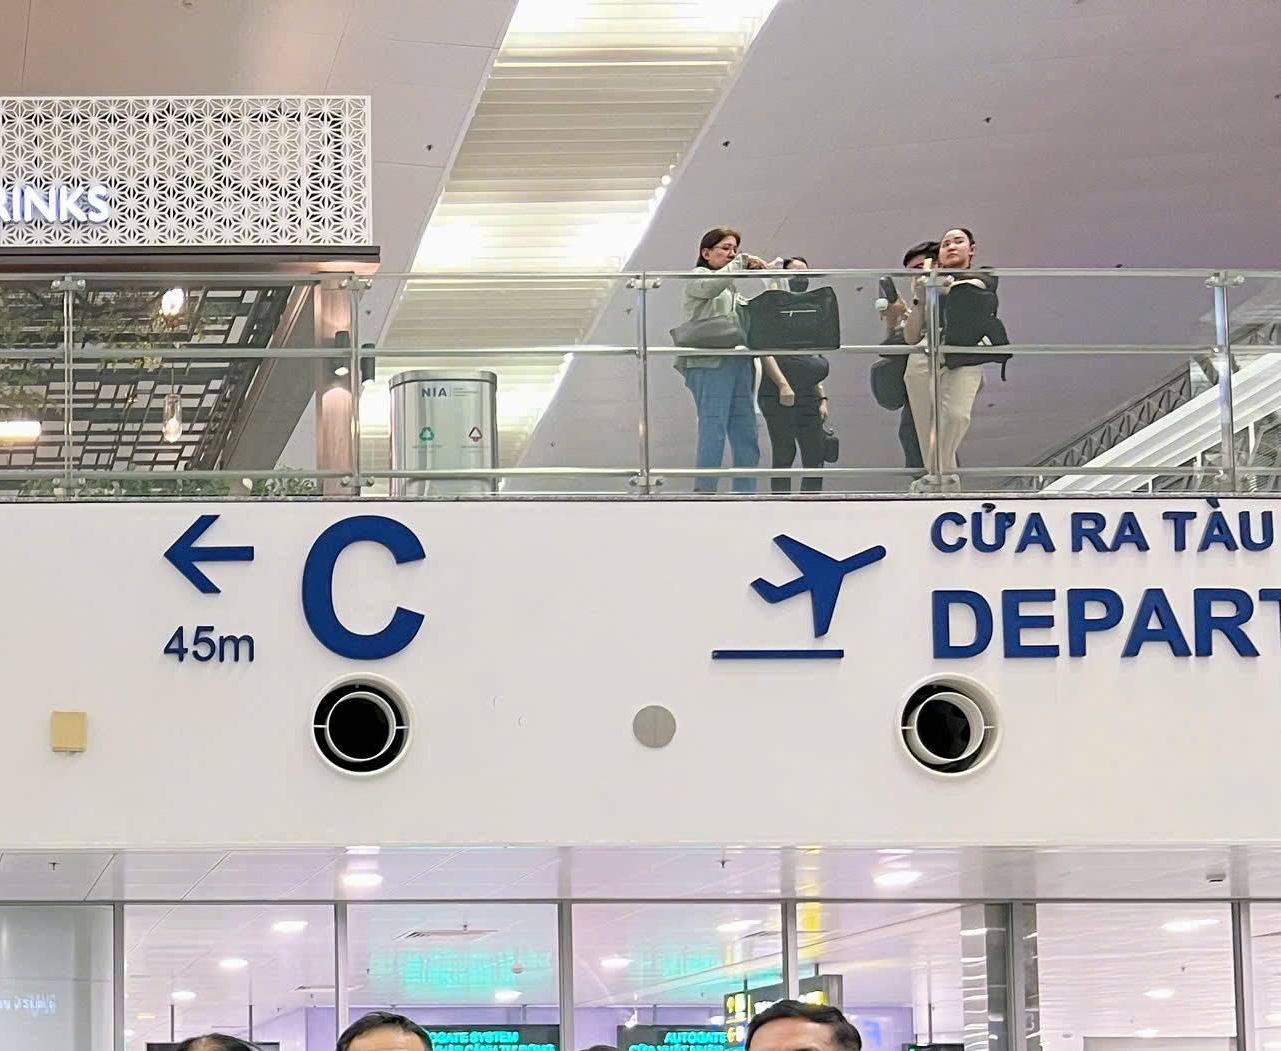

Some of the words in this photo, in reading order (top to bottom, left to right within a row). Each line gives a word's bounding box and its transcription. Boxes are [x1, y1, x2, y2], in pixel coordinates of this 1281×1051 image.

[421, 387, 447, 398] NIA
[931, 503, 1056, 553] CỬA
[1072, 511, 1149, 553] RA
[1163, 497, 1274, 552] TÀU
[302, 514, 426, 660] C
[163, 625, 255, 662] 45m
